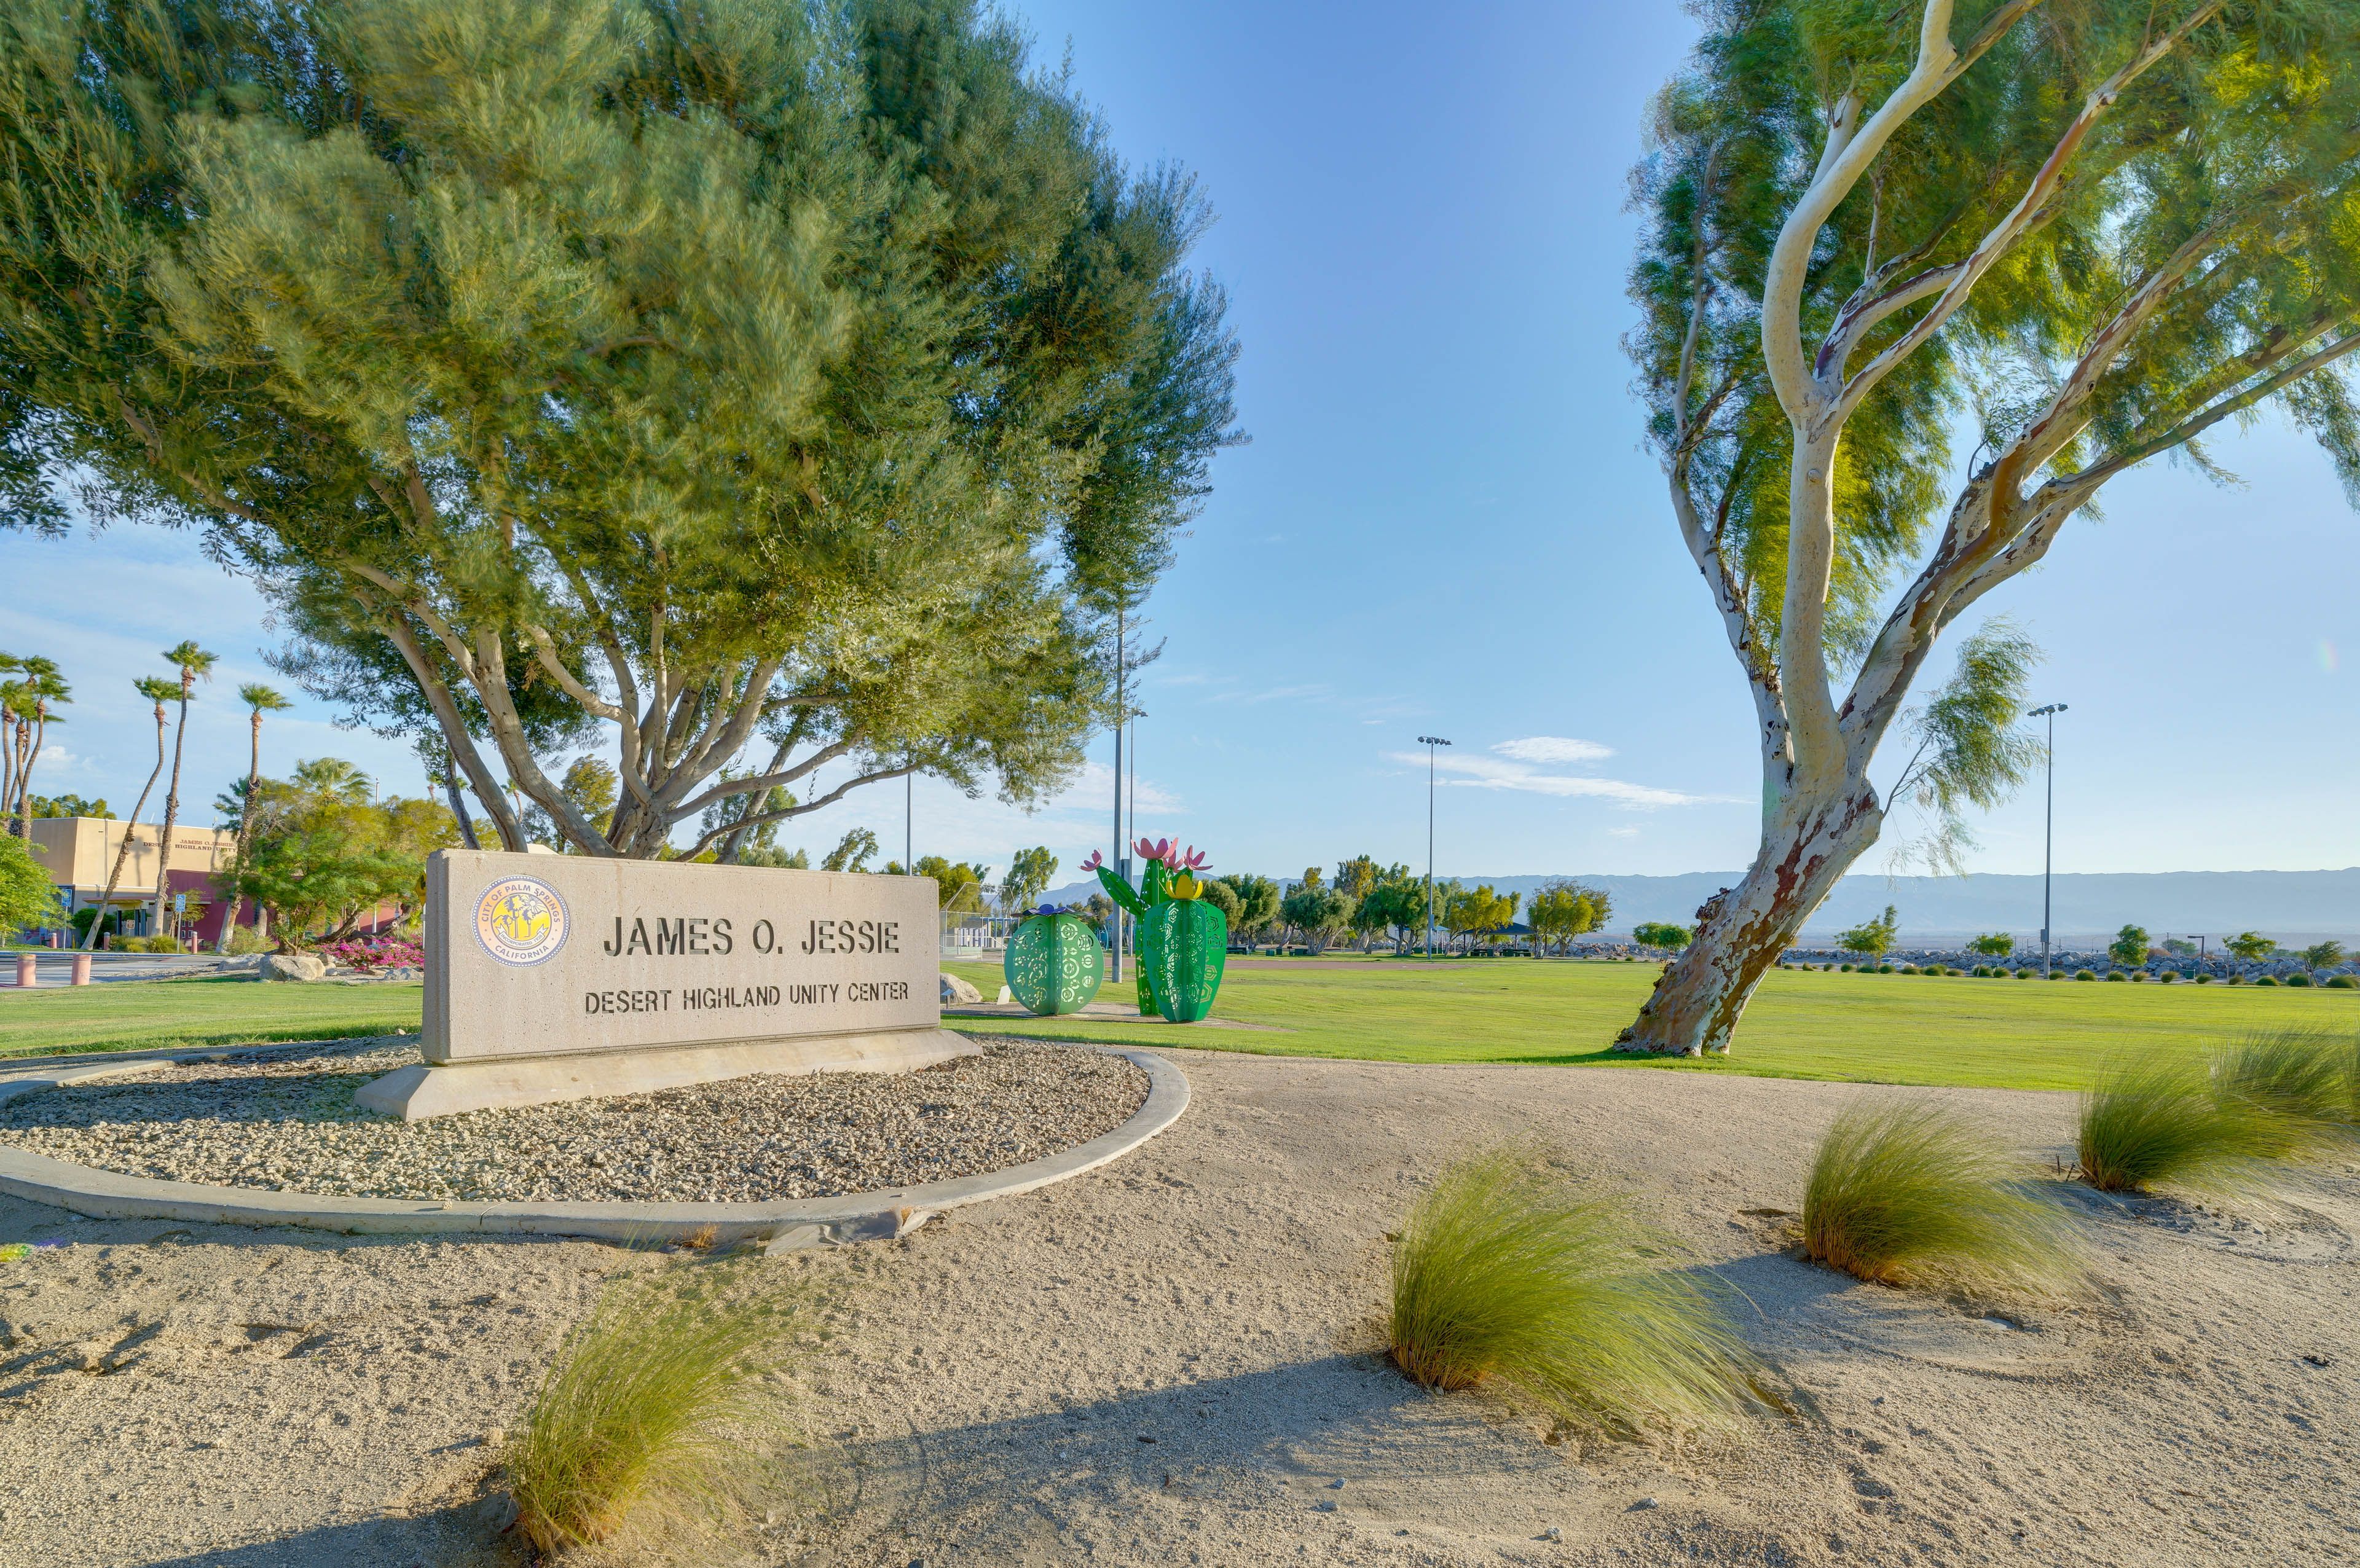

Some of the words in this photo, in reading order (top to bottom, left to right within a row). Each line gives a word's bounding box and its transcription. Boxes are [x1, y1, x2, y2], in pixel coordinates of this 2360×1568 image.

[482, 902, 492, 922] CITY
[492, 890, 503, 901] OF
[534, 888, 560, 922] SPRINGS
[495, 946, 549, 958] CALIFORNIA
[500, 933, 532, 946] INCORPORATED
[604, 917, 733, 956] JAMES
[752, 919, 783, 955] O.
[801, 920, 900, 955] JESSIE
[586, 990, 672, 1014] DESERT
[683, 986, 781, 1009] HIGHLAND
[790, 984, 840, 1005] UNITY
[848, 982, 908, 1002] CENTER
